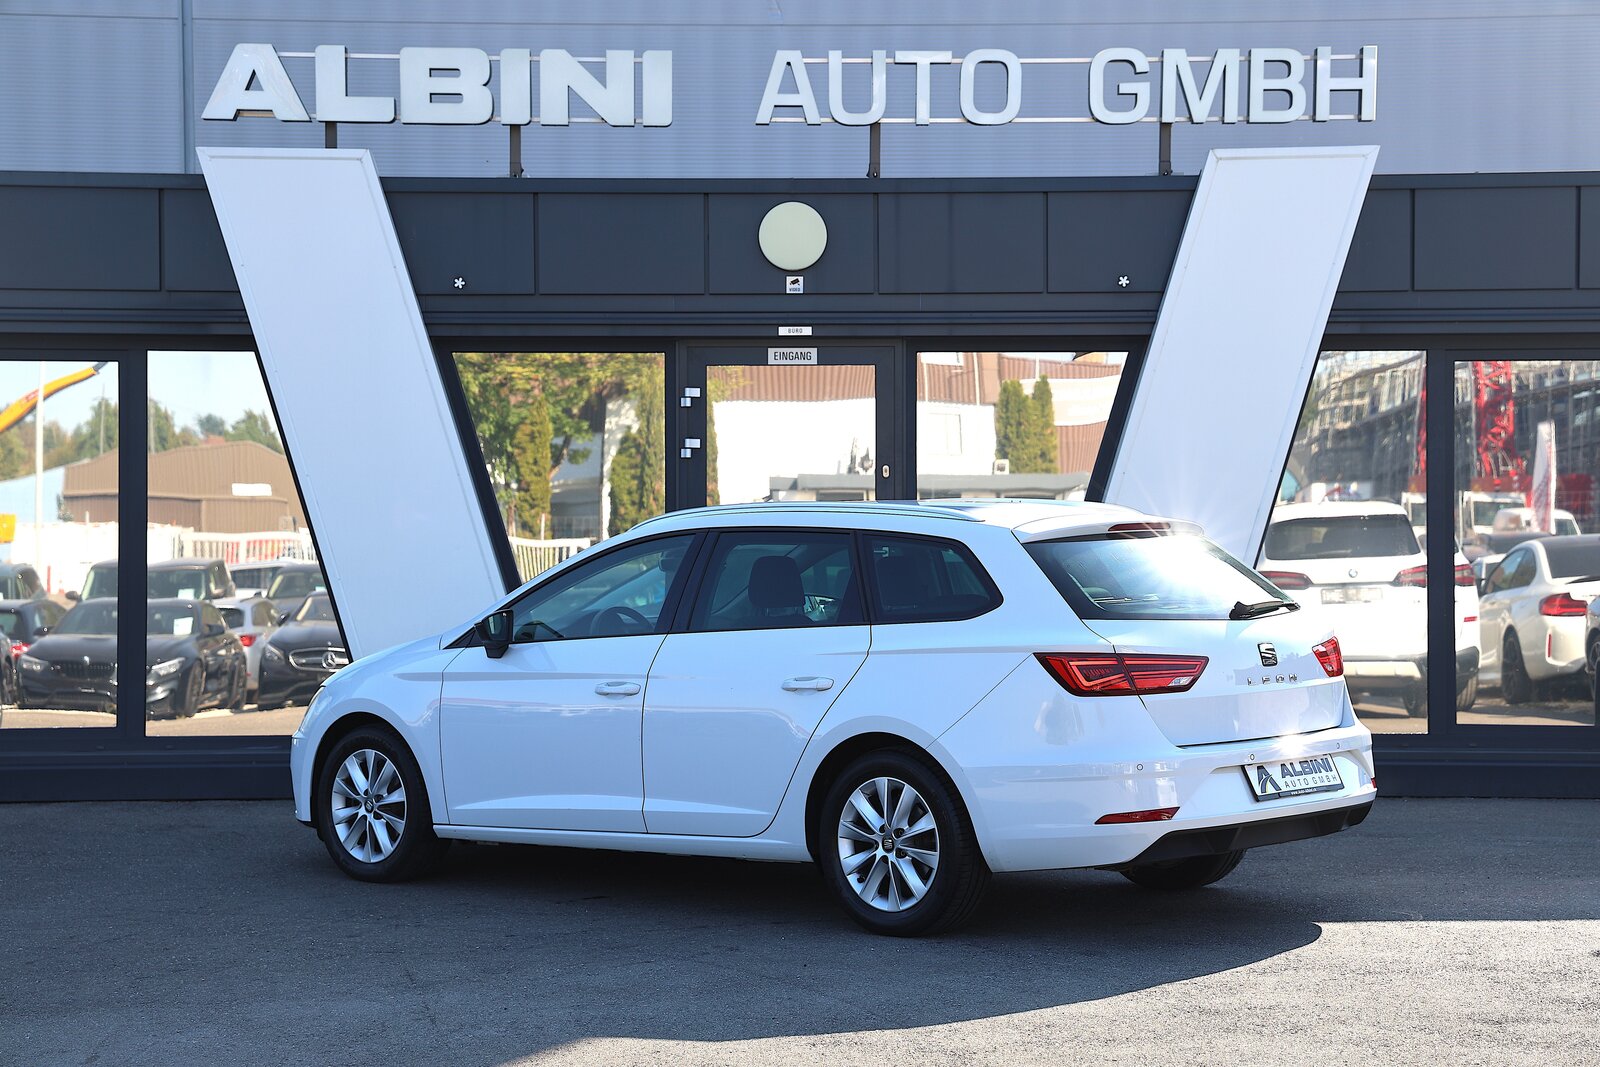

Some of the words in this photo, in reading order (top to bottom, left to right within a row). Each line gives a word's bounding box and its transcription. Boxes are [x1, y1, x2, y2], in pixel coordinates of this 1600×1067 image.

[201, 43, 673, 127] ALBINI
[755, 48, 1022, 126] AUTO
[1089, 45, 1378, 125] GMBH
[774, 351, 812, 361] EINGANG
[1281, 757, 1333, 778] ALBINI
[1284, 777, 1310, 788] AUTO
[1312, 774, 1338, 784] GMBH
